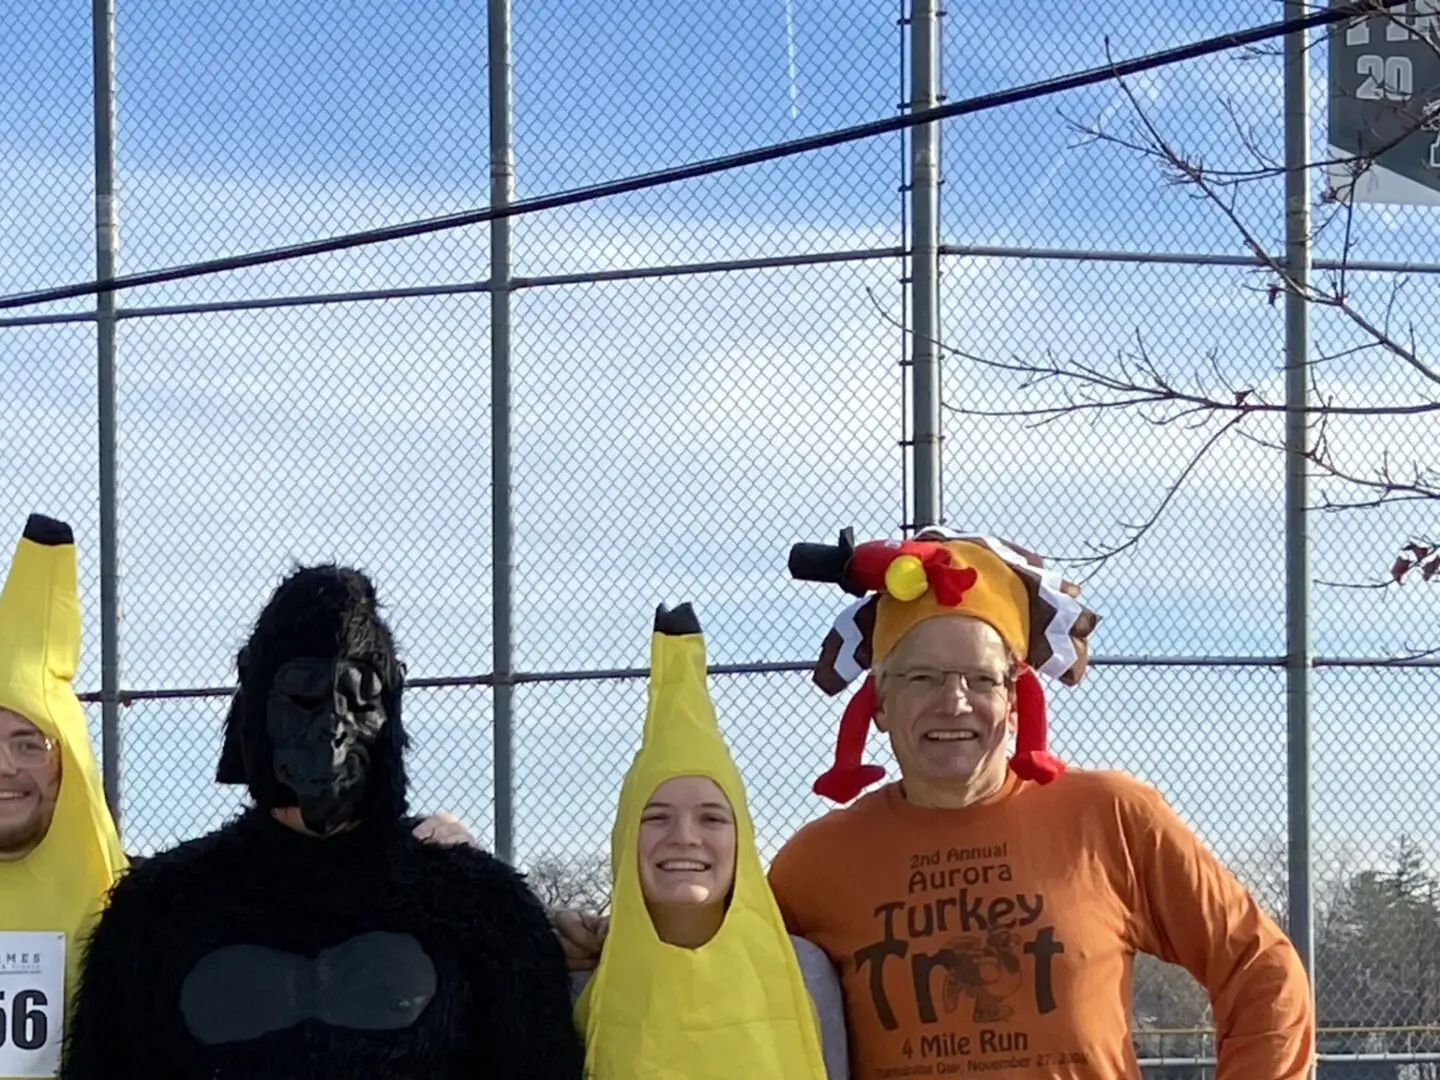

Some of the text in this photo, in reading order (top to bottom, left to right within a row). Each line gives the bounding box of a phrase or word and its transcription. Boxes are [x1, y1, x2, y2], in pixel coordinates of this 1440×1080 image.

[1356, 54, 1413, 100] 20
[910, 842, 1007, 869] 2nd Annual
[908, 863, 1012, 895] Aurora
[873, 889, 1044, 942] Turkey
[902, 1029, 1028, 1060] 4 Mile Run
